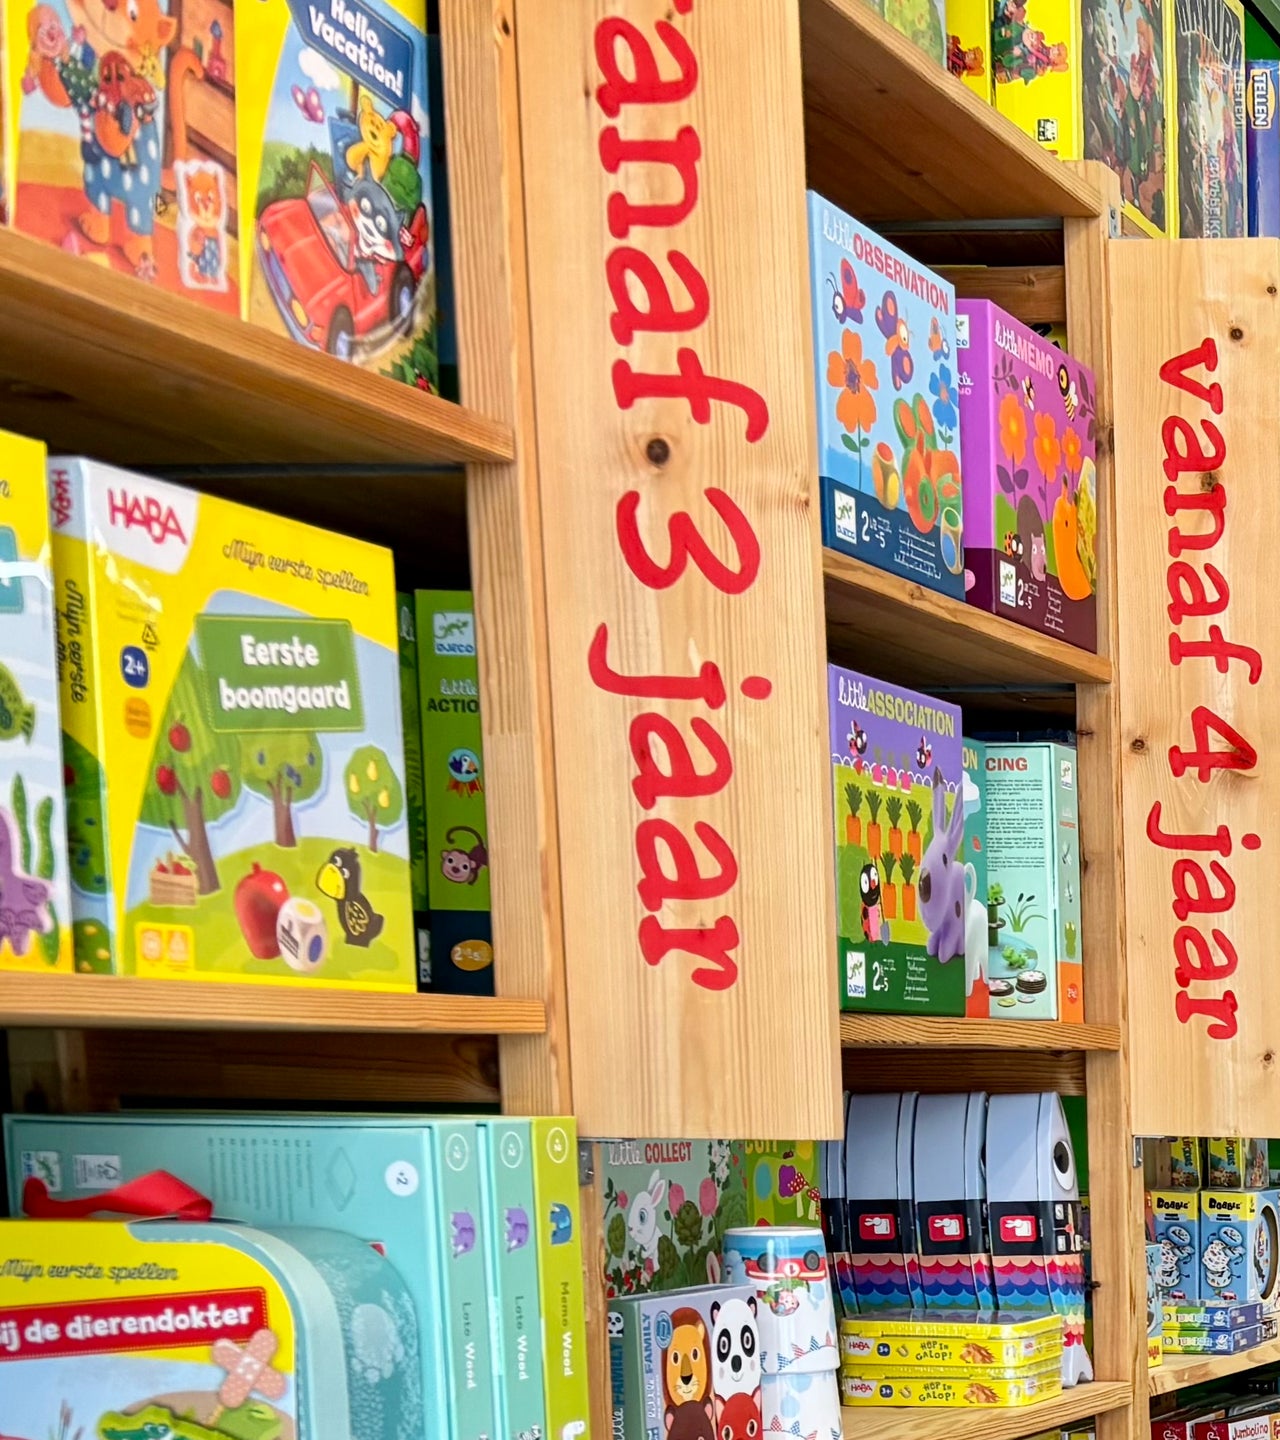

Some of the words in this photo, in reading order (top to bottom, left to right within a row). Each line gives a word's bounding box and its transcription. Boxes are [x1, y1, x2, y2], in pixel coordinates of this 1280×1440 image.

[309, 7, 403, 96] Vacation!
[330, 0, 386, 57] Hello,
[1253, 71, 1268, 127] TELLEN
[595, 0, 768, 443] anaf
[852, 230, 949, 315] OBSERVATION
[52, 468, 72, 529] HABA
[107, 488, 187, 545] HABA
[1158, 336, 1264, 686] vanaf
[616, 486, 760, 594] 3
[222, 538, 265, 569] Mijn
[266, 556, 314, 580] eerste
[315, 569, 371, 596] spellen
[240, 634, 321, 667] Eerste
[218, 678, 352, 715] boomgaard
[837, 677, 868, 711] little
[867, 687, 955, 738] ASSOCIATION
[1168, 705, 1258, 784] 4
[588, 622, 772, 991] jaar
[1146, 800, 1262, 1041] jaar
[645, 1141, 692, 1164] COLLECT
[1156, 1198, 1189, 1210] DOBBLE
[1209, 1198, 1240, 1210] DOBBLE
[48, 1261, 101, 1280] eerste
[107, 1259, 179, 1281] spellen
[23, 1320, 57, 1342] de
[65, 1304, 254, 1339] dierendokter
[462, 1302, 472, 1337] Loto
[515, 1295, 524, 1331] Loto
[462, 1339, 476, 1390] Wood
[517, 1333, 529, 1380] Wood
[561, 1333, 574, 1378] Wood
[642, 1313, 653, 1374] FAMILY
[849, 1341, 870, 1351] HABA
[916, 1351, 953, 1361] GALOP!
[851, 1383, 872, 1393] HABA
[918, 1392, 955, 1402] GALOP!
[1232, 1423, 1269, 1440] Jumbolino
